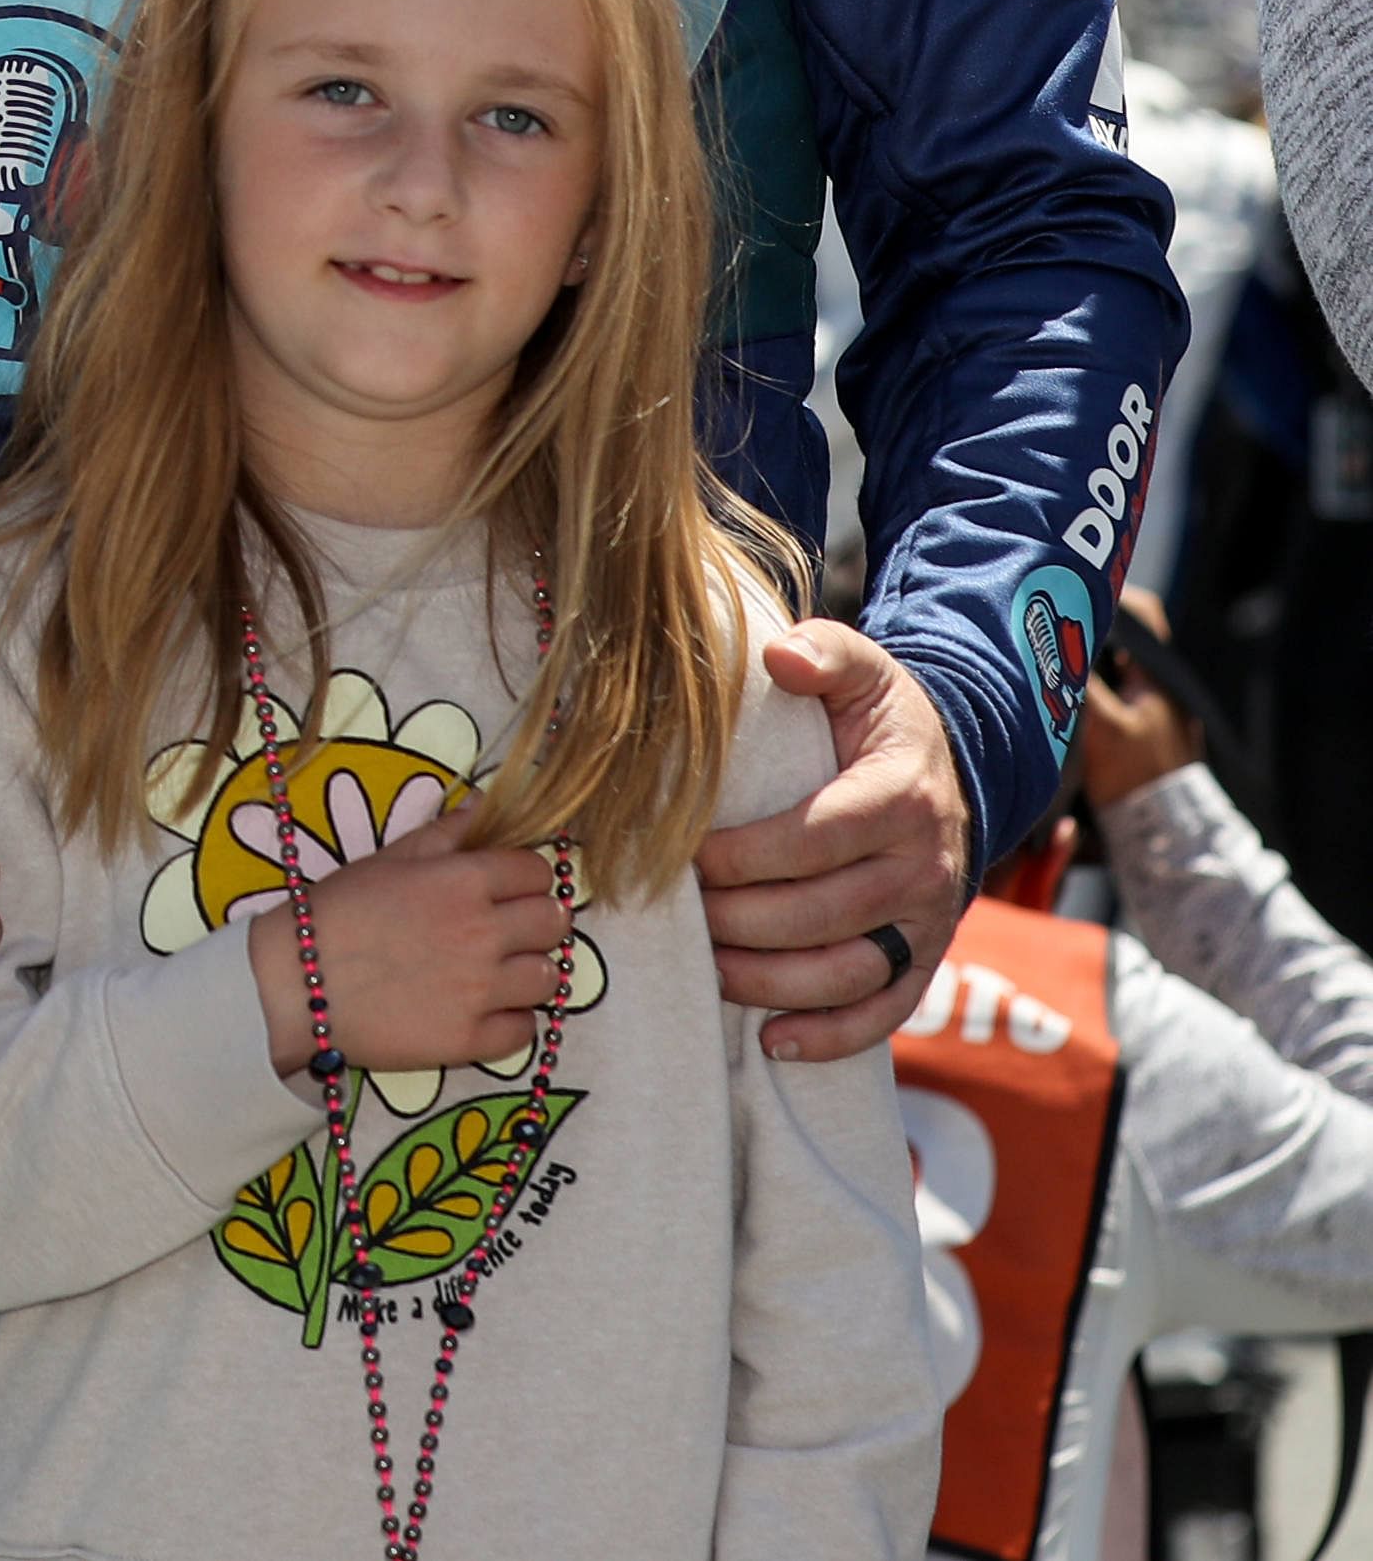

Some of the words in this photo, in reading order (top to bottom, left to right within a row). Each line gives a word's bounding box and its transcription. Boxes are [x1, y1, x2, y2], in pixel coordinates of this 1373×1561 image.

[1061, 383, 1154, 570] DOOR
[337, 1293, 399, 1324] Mke
[412, 1296, 423, 1319] a
[518, 1161, 577, 1227] today
